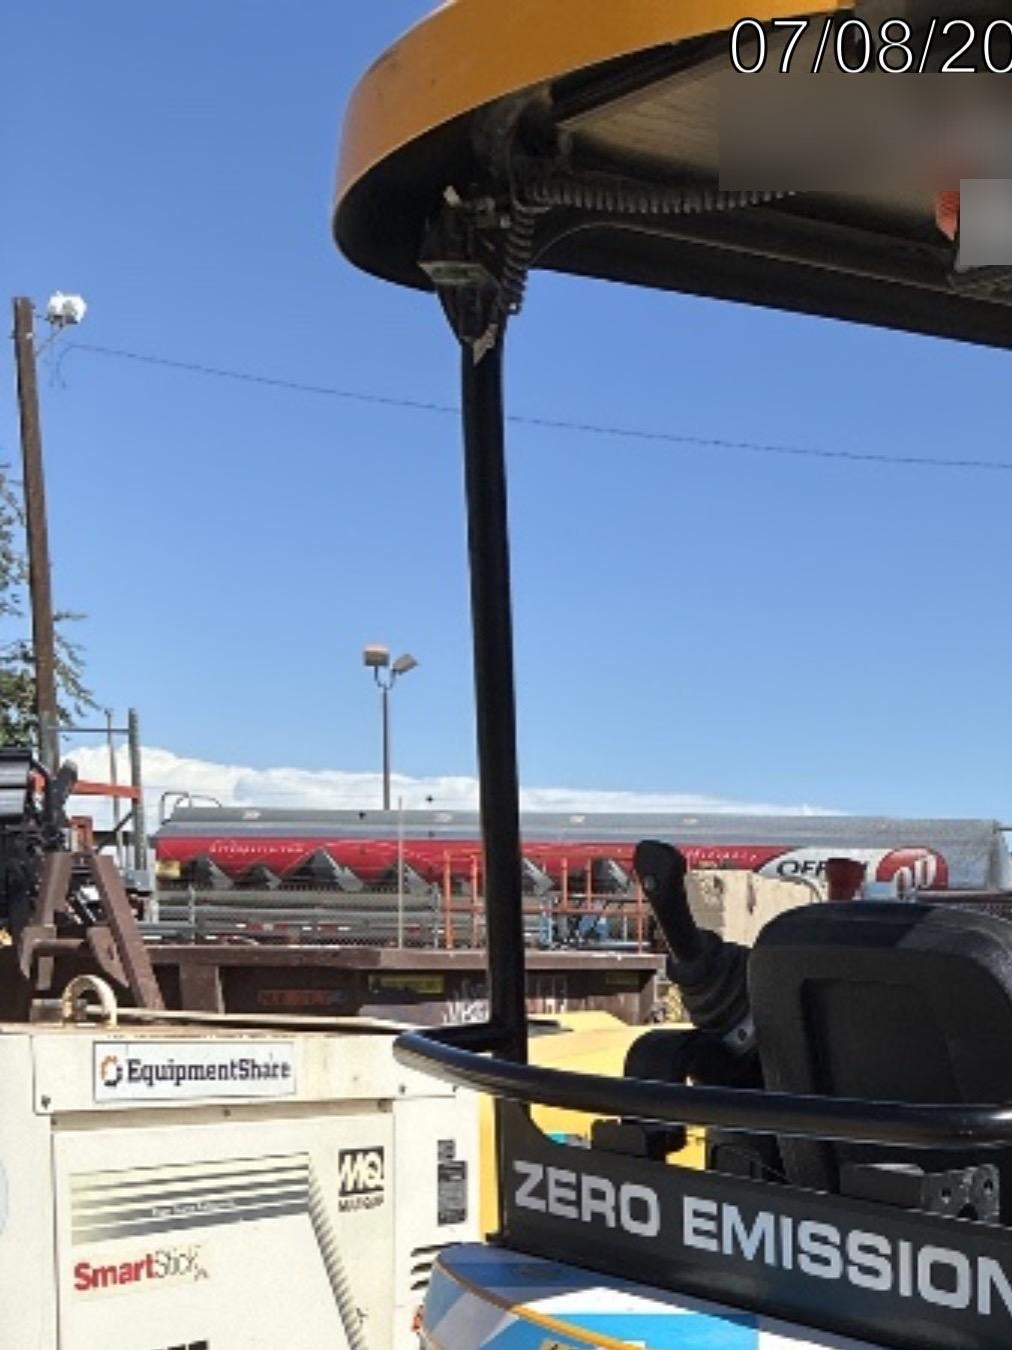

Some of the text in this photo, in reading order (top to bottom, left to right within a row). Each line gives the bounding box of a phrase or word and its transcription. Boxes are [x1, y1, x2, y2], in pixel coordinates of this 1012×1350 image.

[126, 1058, 291, 1086] EquipmentShare
[339, 1150, 384, 1192] MQ
[512, 1160, 661, 1238] ZERO
